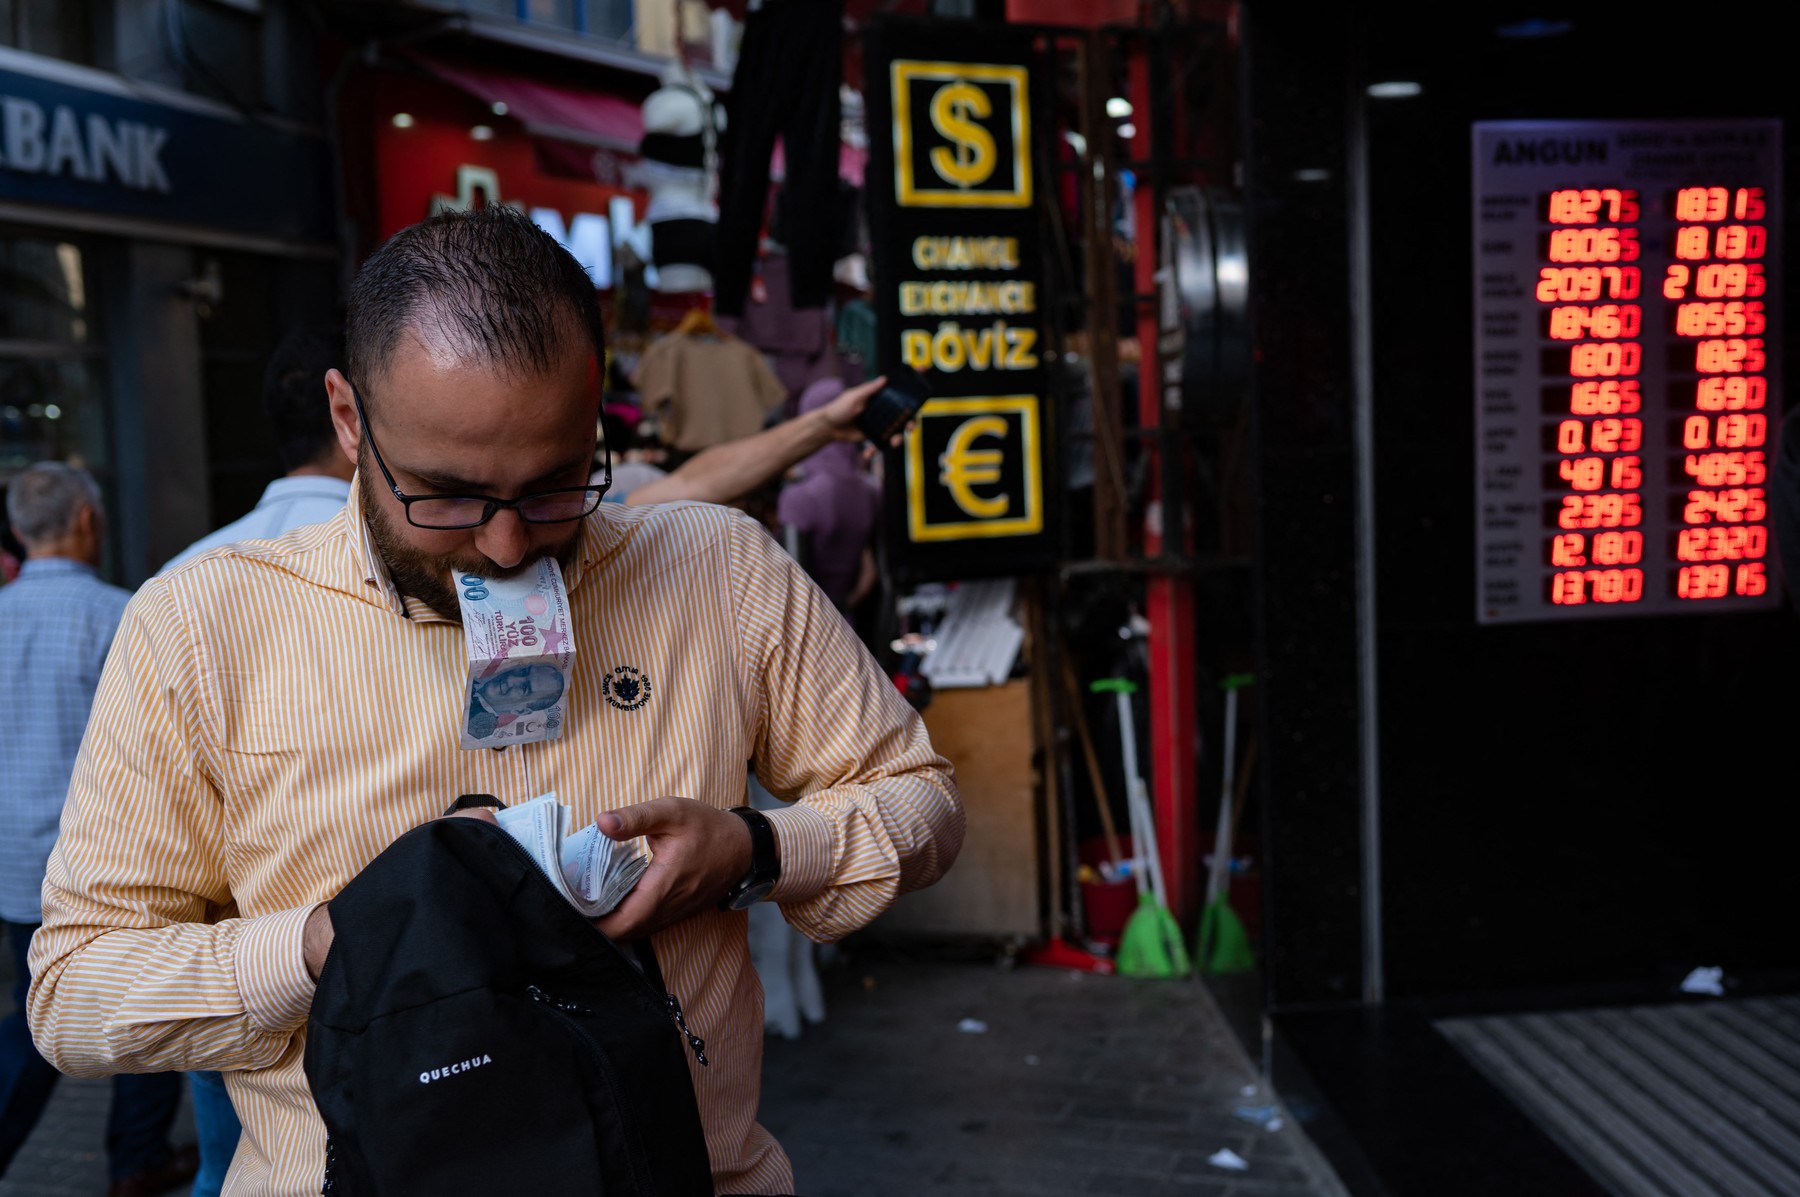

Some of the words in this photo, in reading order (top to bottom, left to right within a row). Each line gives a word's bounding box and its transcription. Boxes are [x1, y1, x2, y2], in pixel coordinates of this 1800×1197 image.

[0, 96, 172, 194] BANK
[901, 321, 1039, 372] DÖVİZ
[494, 609, 505, 633] TÜRK
[505, 620, 520, 648] YÜZ
[518, 615, 538, 647] 100
[498, 634, 510, 661] LİRASI
[602, 673, 613, 696] SINCE
[419, 1053, 492, 1084] QUECHUA
